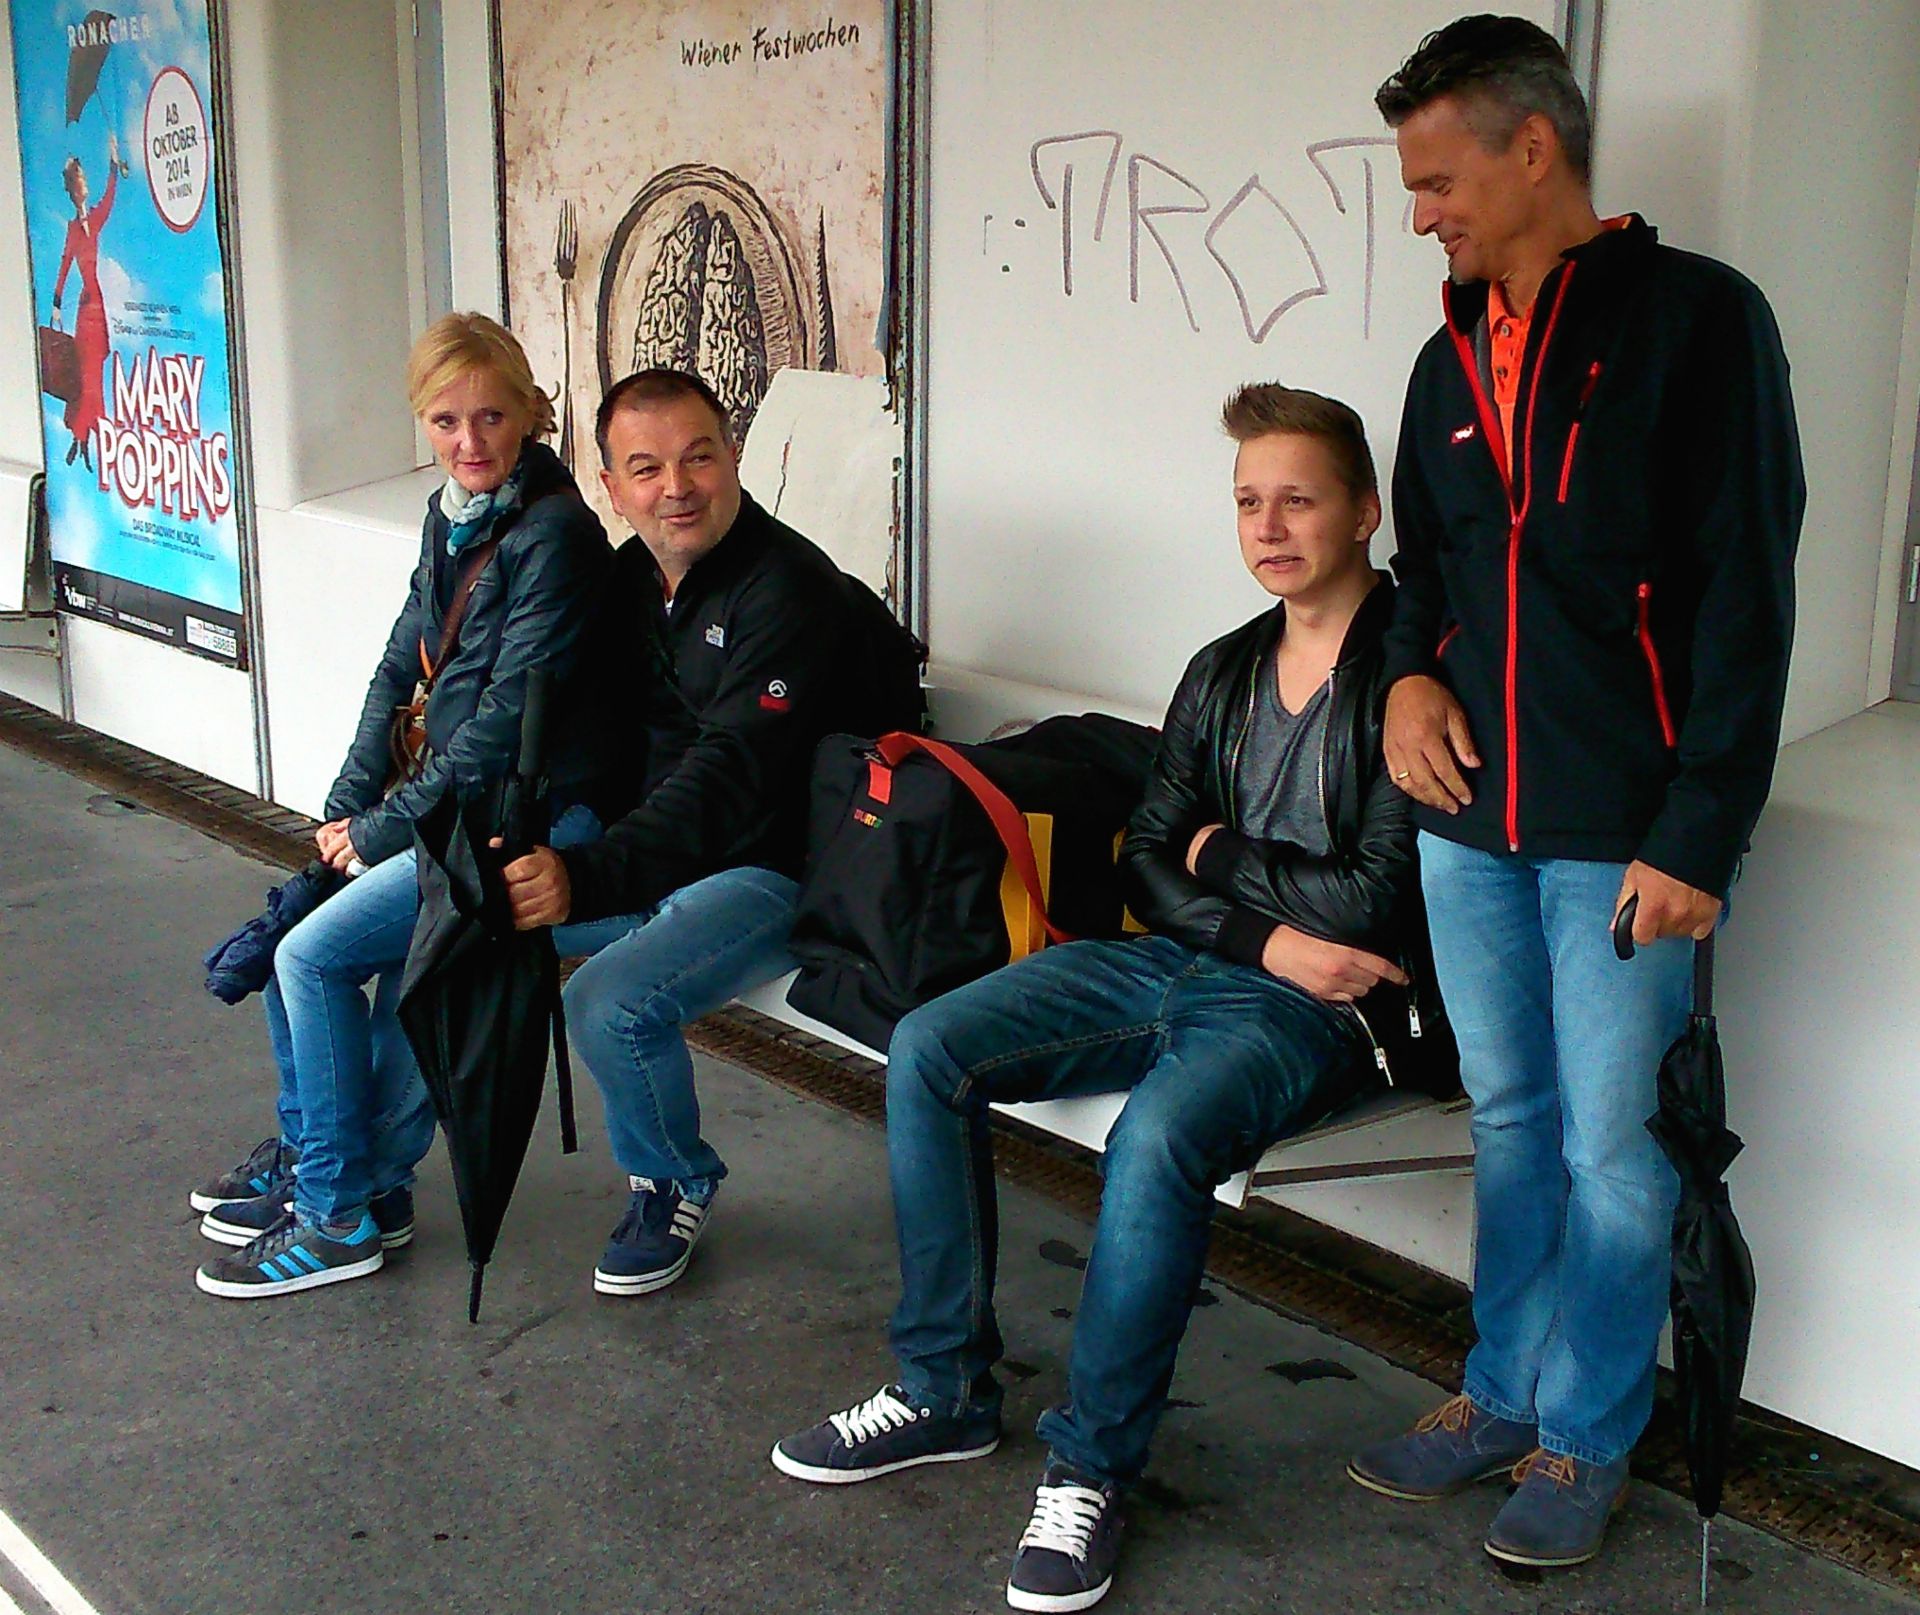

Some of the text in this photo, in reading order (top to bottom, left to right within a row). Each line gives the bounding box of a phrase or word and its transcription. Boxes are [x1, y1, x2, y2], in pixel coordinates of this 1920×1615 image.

[67, 13, 151, 48] RONACHER
[681, 17, 861, 68] Wiener Festwochen
[165, 102, 179, 127] AB
[153, 125, 198, 159] OKTOBER
[165, 156, 190, 183] 2014
[113, 345, 205, 438] MARY
[98, 416, 231, 524] POPPINS
